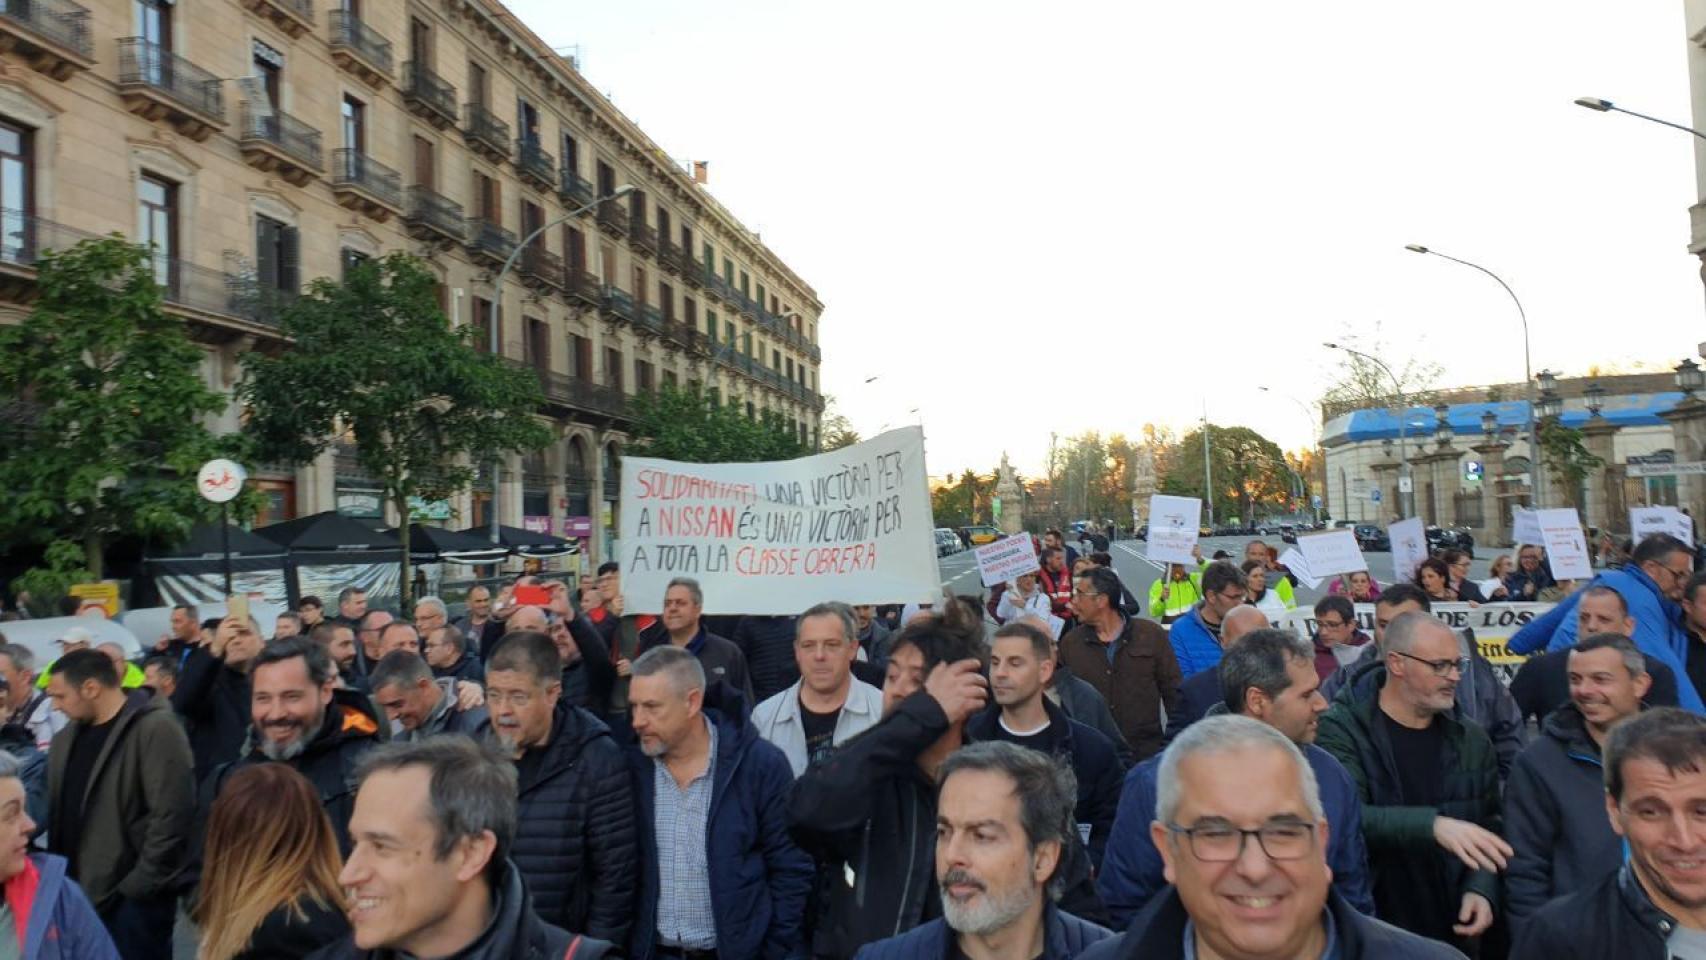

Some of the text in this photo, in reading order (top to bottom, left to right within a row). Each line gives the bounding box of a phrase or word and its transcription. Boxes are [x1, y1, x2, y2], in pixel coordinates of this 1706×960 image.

[765, 481, 804, 507] UNA
[876, 451, 903, 495] PER
[637, 494, 902, 544] A NISSAN ÉS UNA VICTÒRIA PER
[630, 542, 876, 576] A TOTA LA CLASSE OBRERA
[1437, 610, 1536, 628] DE LOS
